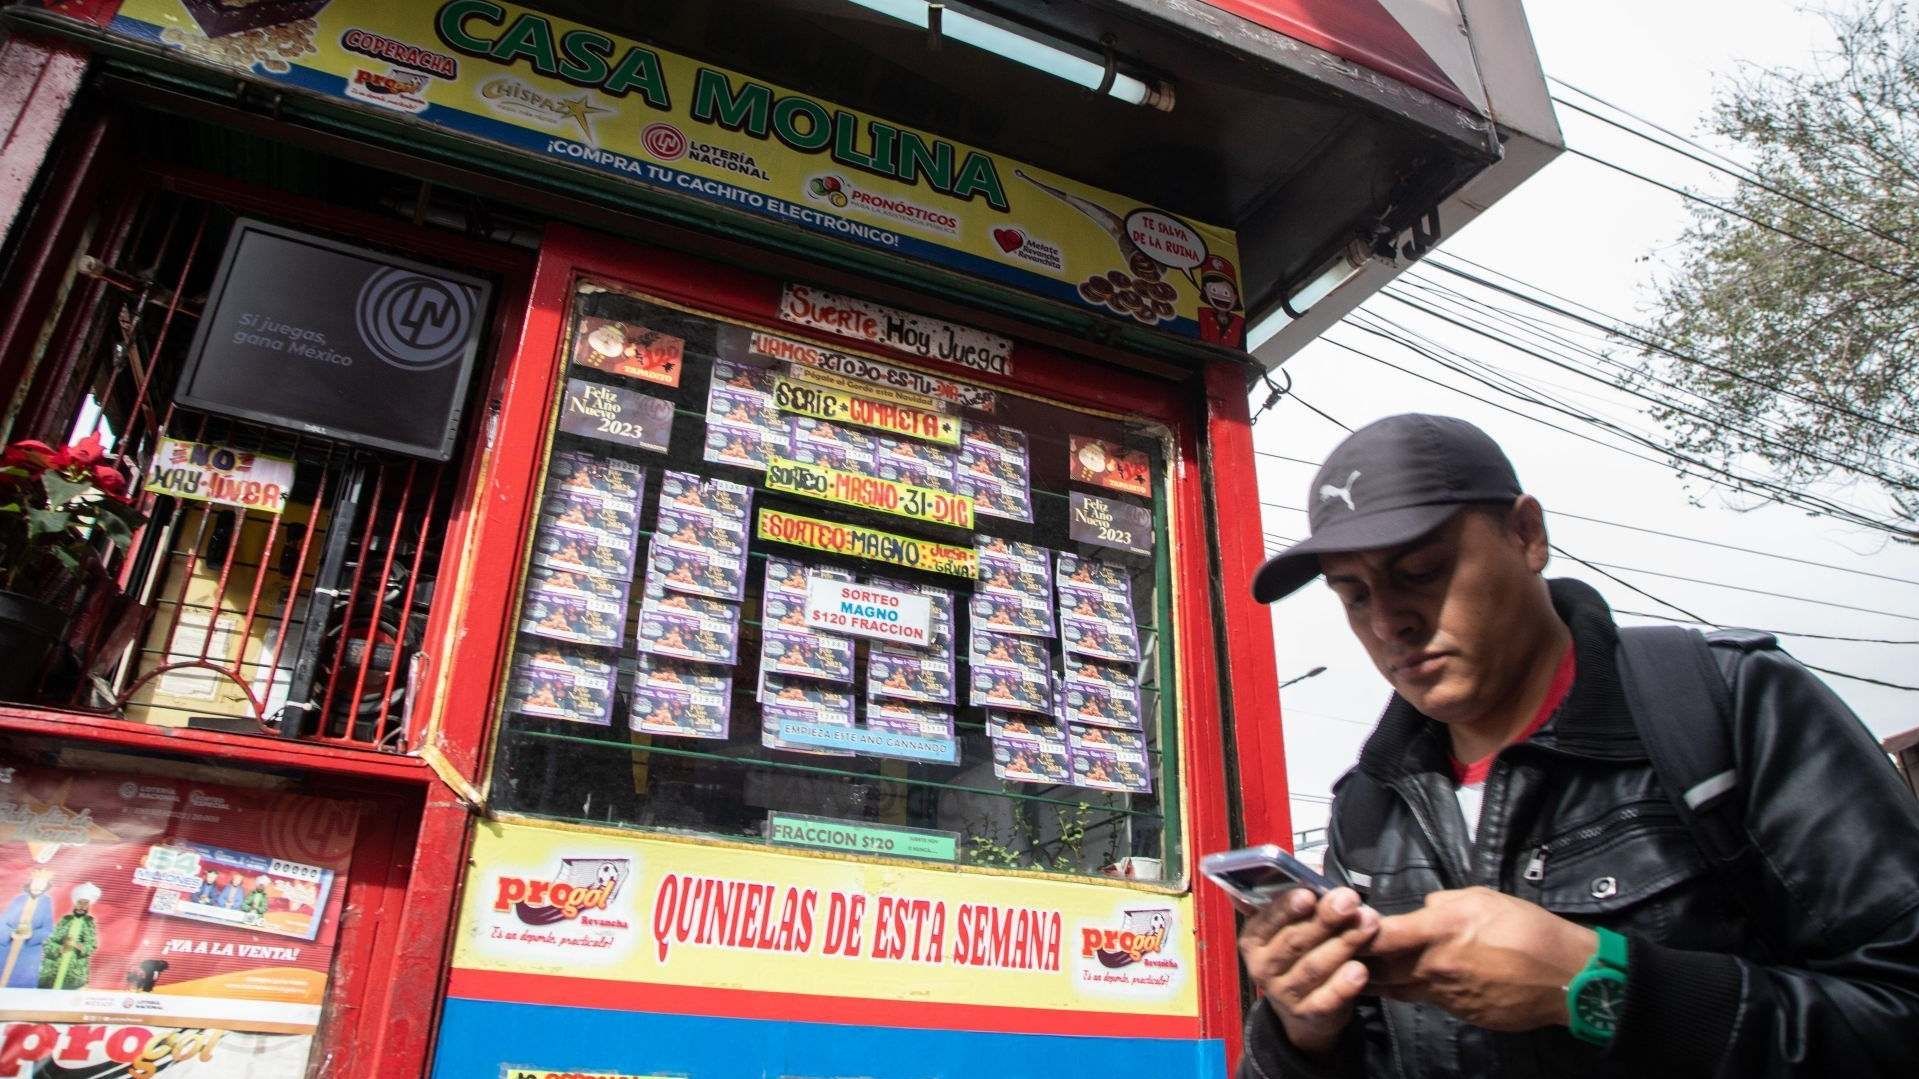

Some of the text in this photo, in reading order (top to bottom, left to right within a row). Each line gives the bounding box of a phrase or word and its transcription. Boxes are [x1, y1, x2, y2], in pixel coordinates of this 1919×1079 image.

[345, 30, 454, 75] COPERACHA
[437, 0, 1010, 212] CASA MOLINA
[688, 152, 770, 181] NACIONAL
[689, 140, 758, 167] LOTERÍA
[547, 139, 899, 247] ¡COMPRA TU CACHITO ELECTRÓNICO!
[851, 189, 958, 229] PRONÓSTICOS
[1142, 216, 1189, 242] TE SALVA
[1017, 251, 1062, 270] Revanchita
[1022, 245, 1060, 263] Revancha
[1026, 239, 1058, 255] Melate
[1132, 230, 1201, 263] DE LA RUINA
[238, 312, 327, 347] Si juegas,
[232, 328, 354, 368] gana México
[886, 315, 931, 356] Hoy
[938, 325, 1006, 375] Juega
[584, 384, 619, 403] Feliz
[895, 391, 933, 406] Navidad
[568, 395, 616, 421] Nuevo
[596, 417, 645, 440] 2023
[189, 443, 236, 472] NO
[768, 465, 970, 528] SORTEO MAGNO 31 DIC
[1082, 496, 1108, 513] Feliz
[1073, 506, 1111, 529] Nuevo
[767, 514, 921, 566] SORTEO MAGNO
[1097, 526, 1133, 546] 2023
[840, 587, 900, 608] SORTEO
[811, 609, 924, 641] $120 FRACCION
[839, 601, 900, 623] MAGNO
[783, 722, 832, 741] EMPIEZA
[833, 730, 858, 745] ESTE
[772, 823, 895, 852] FRACCION $120
[493, 875, 617, 921] progol
[580, 915, 629, 930] Revancha
[652, 872, 1063, 972] QUINIELAS DE ESTA SEMANA
[161, 937, 300, 962] ¡YA A LA VENTA!
[1080, 927, 1166, 963] progol
